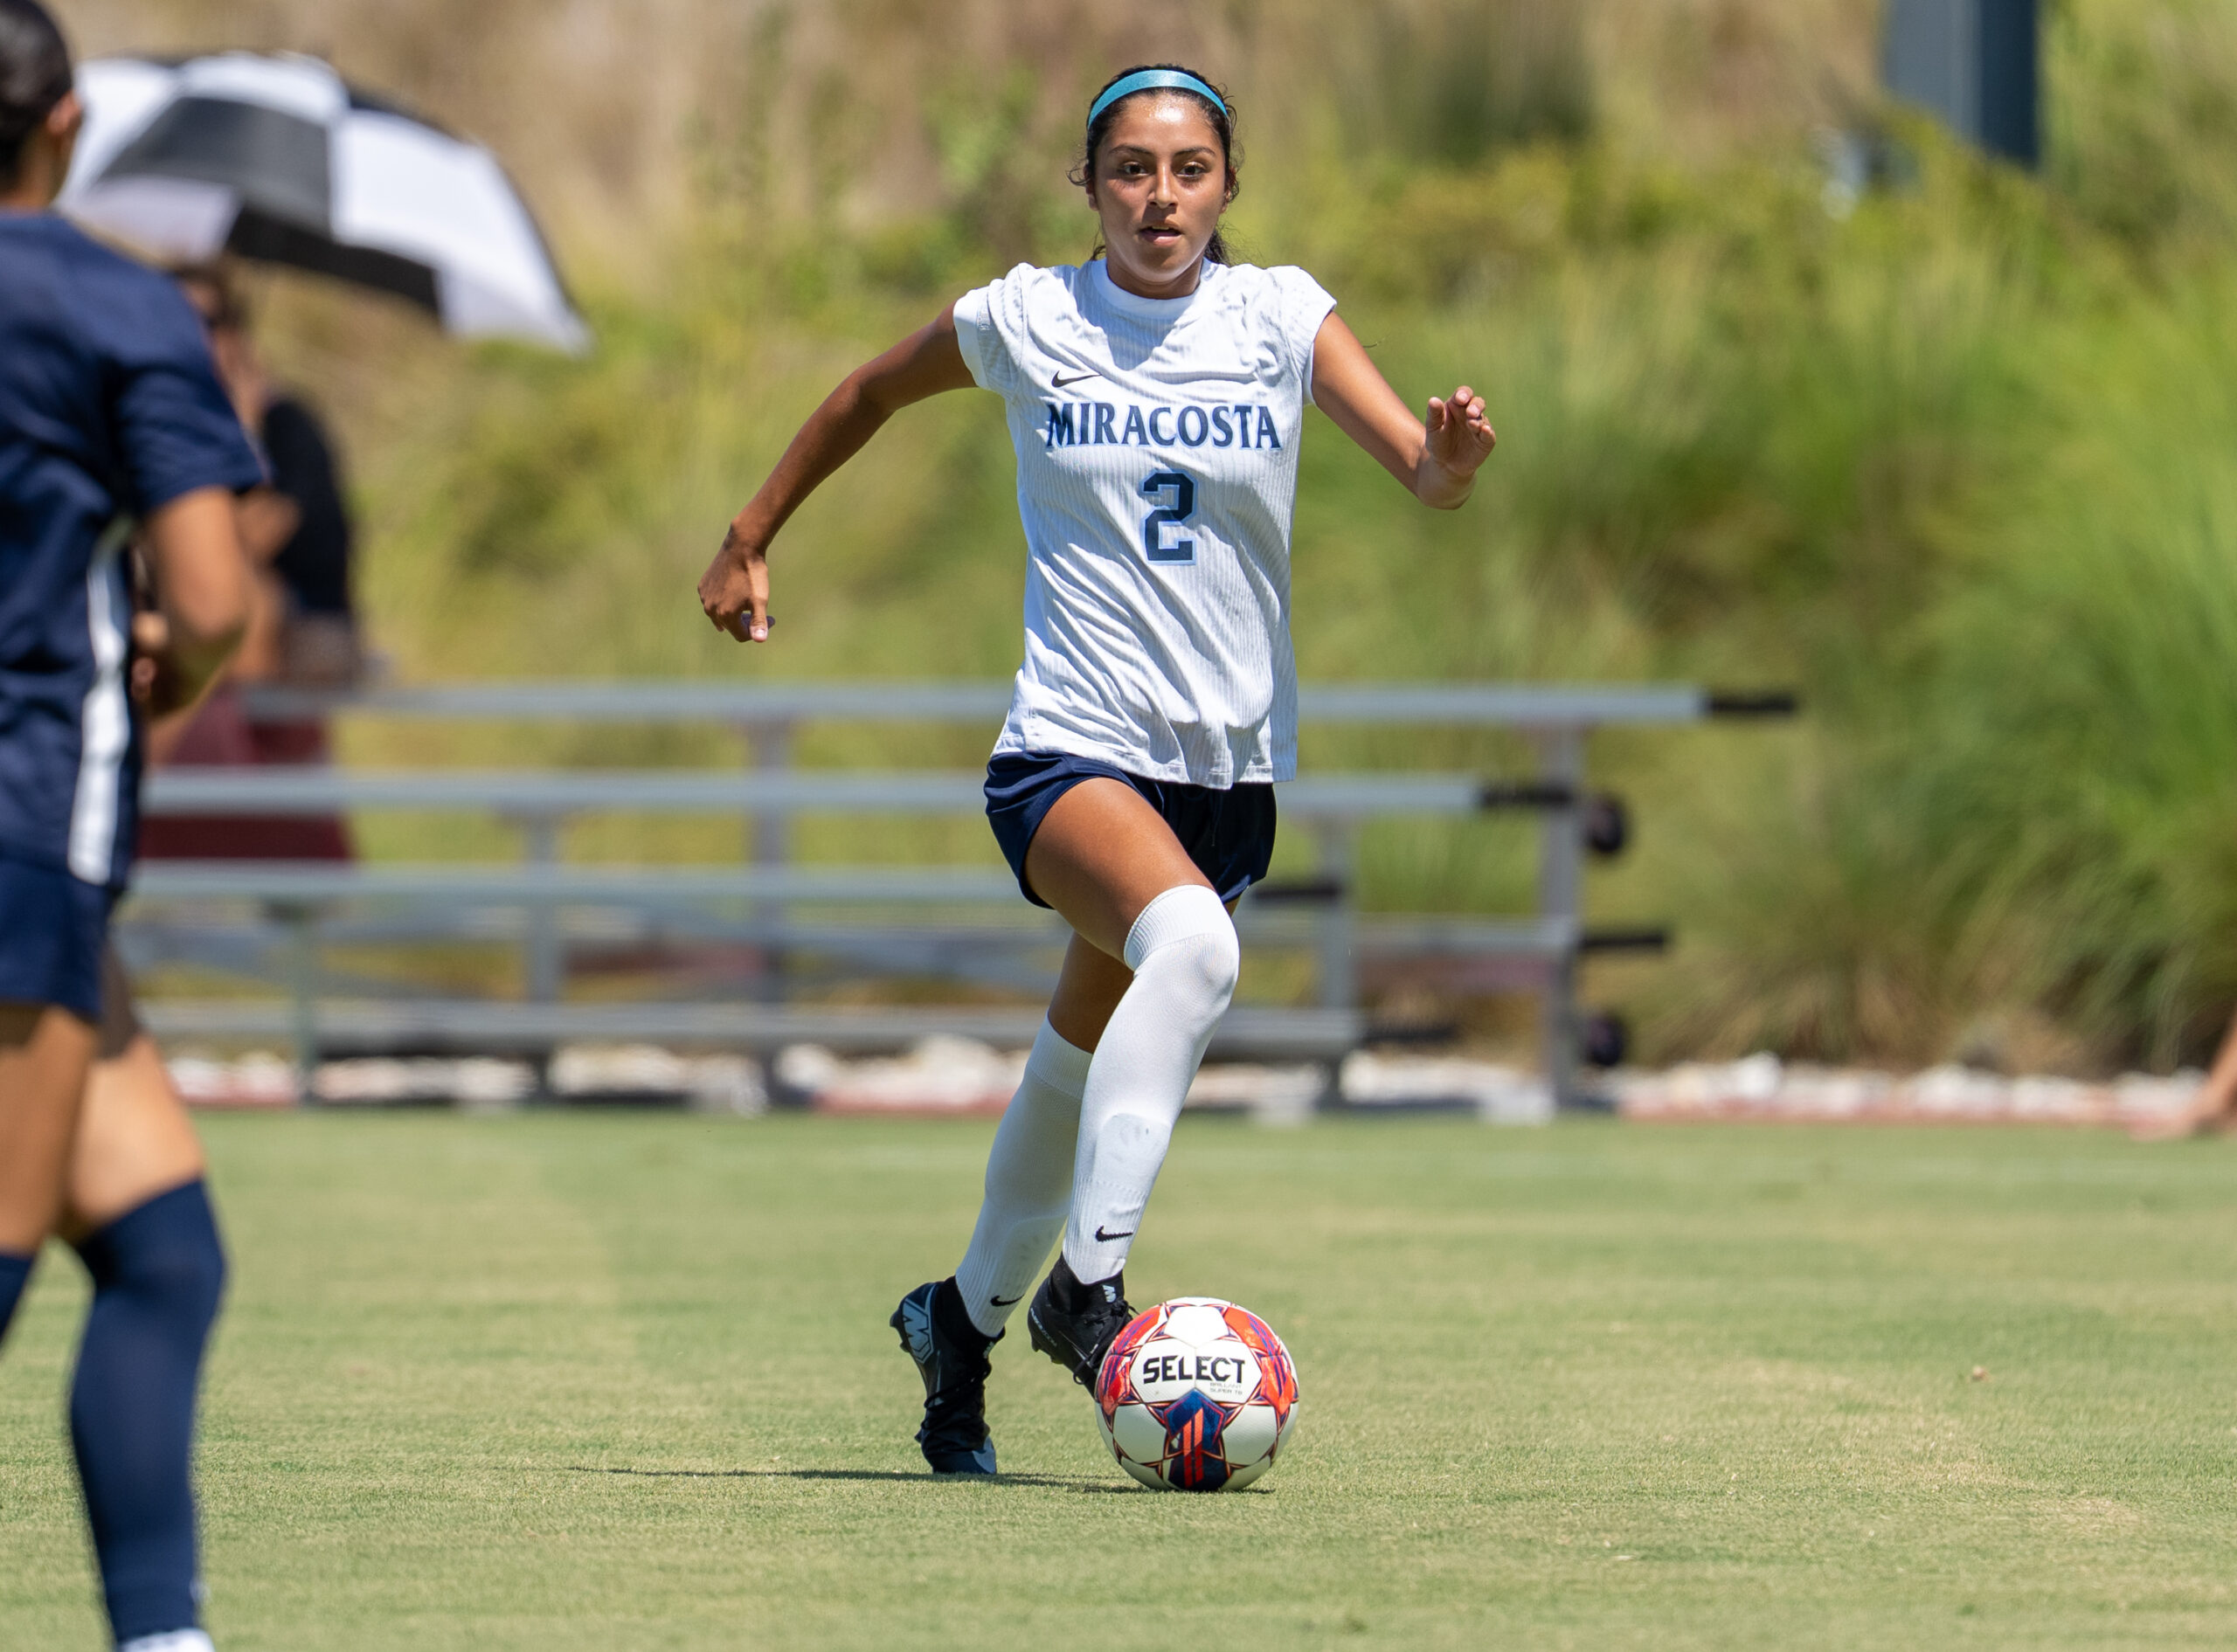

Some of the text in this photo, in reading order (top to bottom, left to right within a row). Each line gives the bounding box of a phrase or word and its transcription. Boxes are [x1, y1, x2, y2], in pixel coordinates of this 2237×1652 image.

[1049, 402, 1283, 450] MIRACOSTA
[1142, 470, 1196, 564] 2
[1143, 1355, 1245, 1384] SELECT
